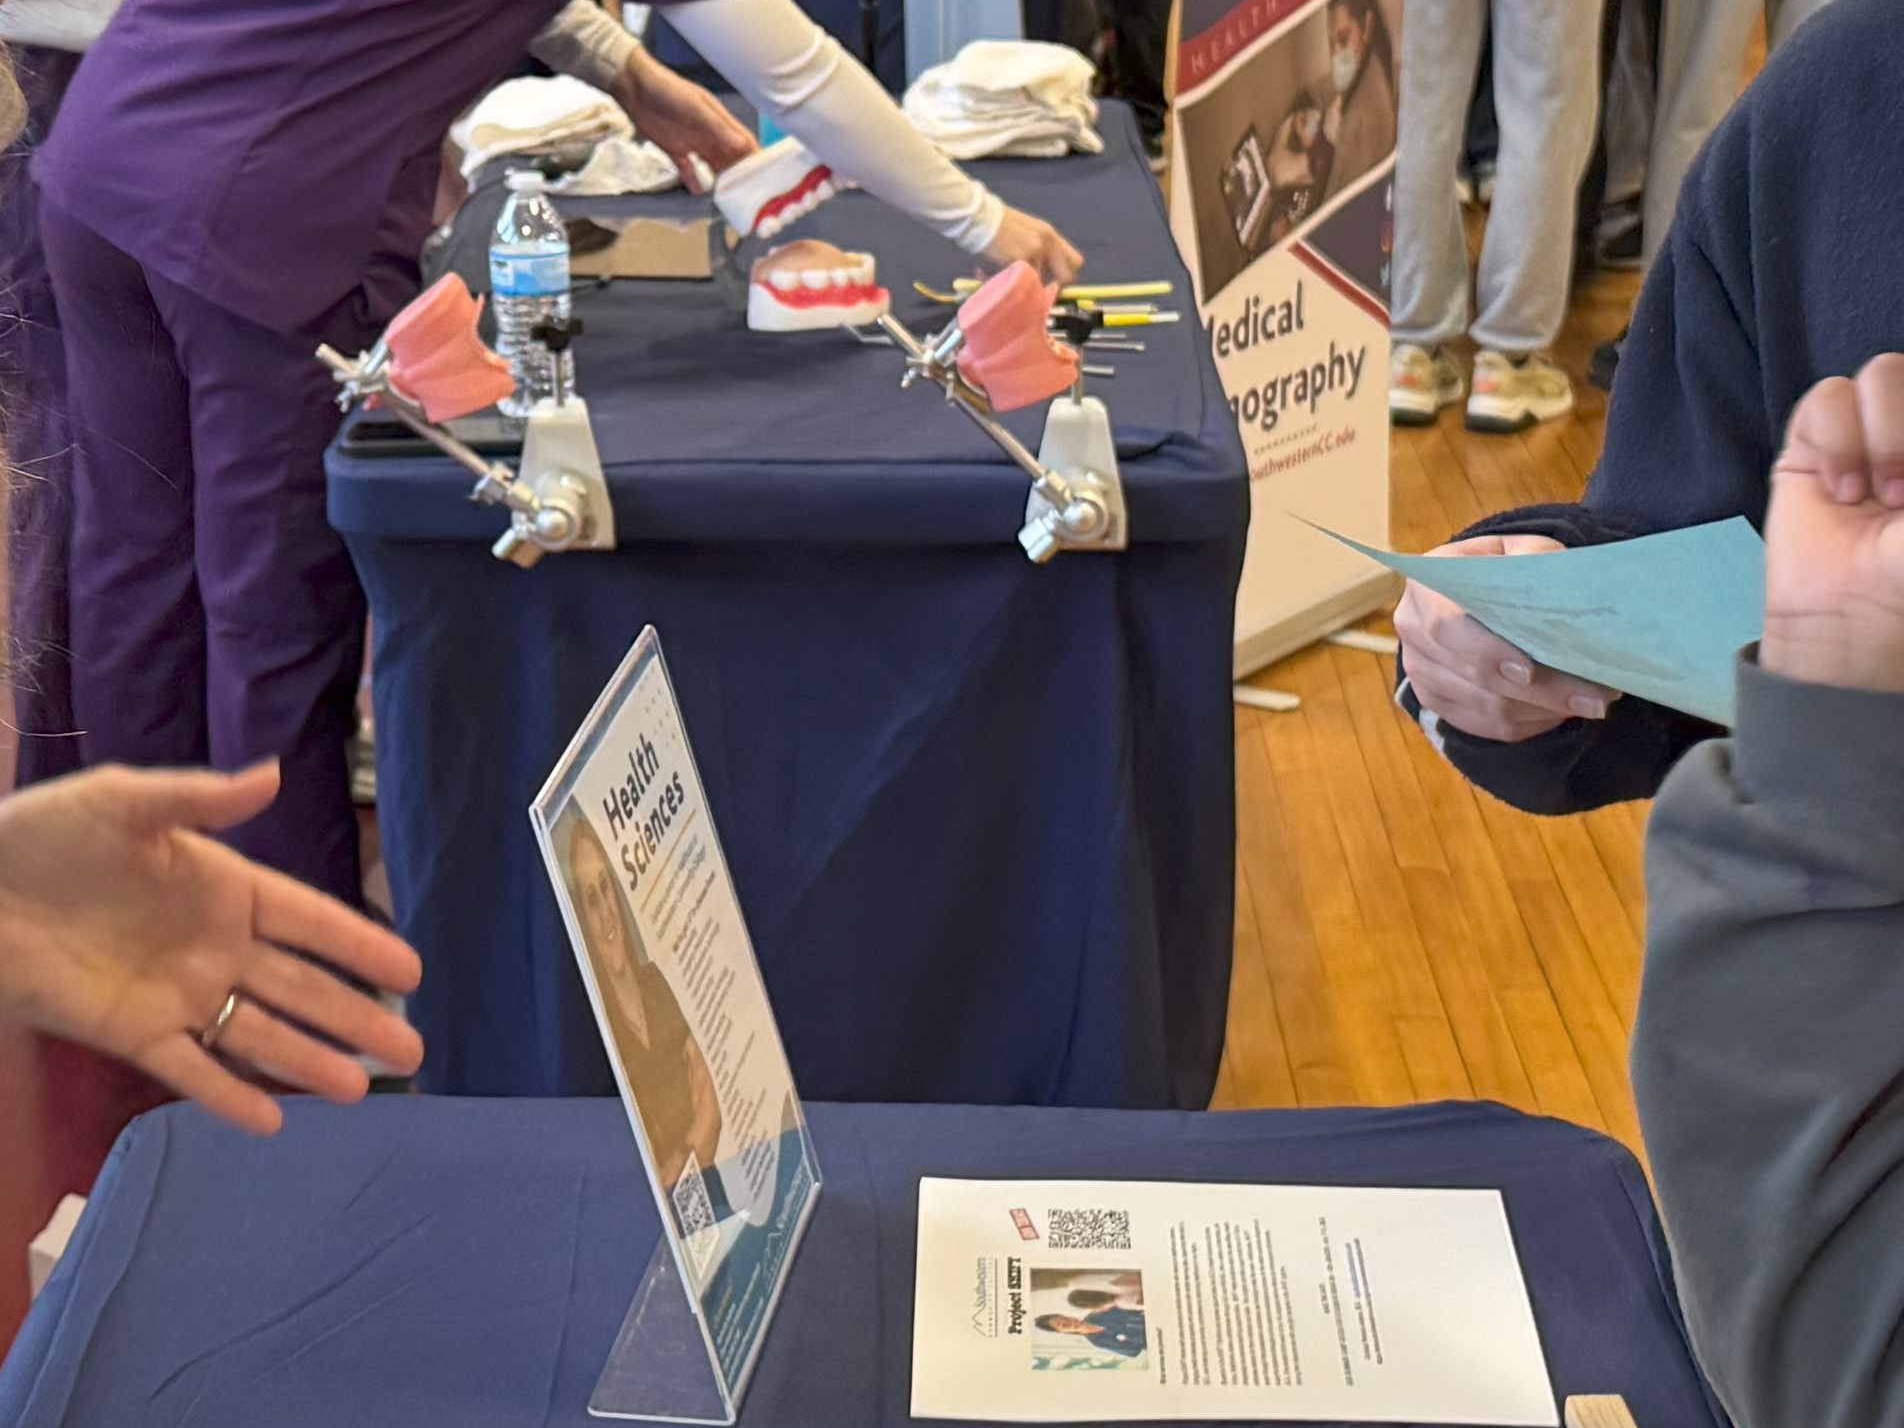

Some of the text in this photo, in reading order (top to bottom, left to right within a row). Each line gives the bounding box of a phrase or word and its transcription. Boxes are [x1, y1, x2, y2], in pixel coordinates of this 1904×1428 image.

[1230, 341, 1366, 432] nography
[1250, 429, 1356, 483] outhwesternCC.edu
[602, 732, 659, 841] Health
[620, 771, 685, 892] Sciences
[1006, 1256, 1028, 1335] Project SHIFT
